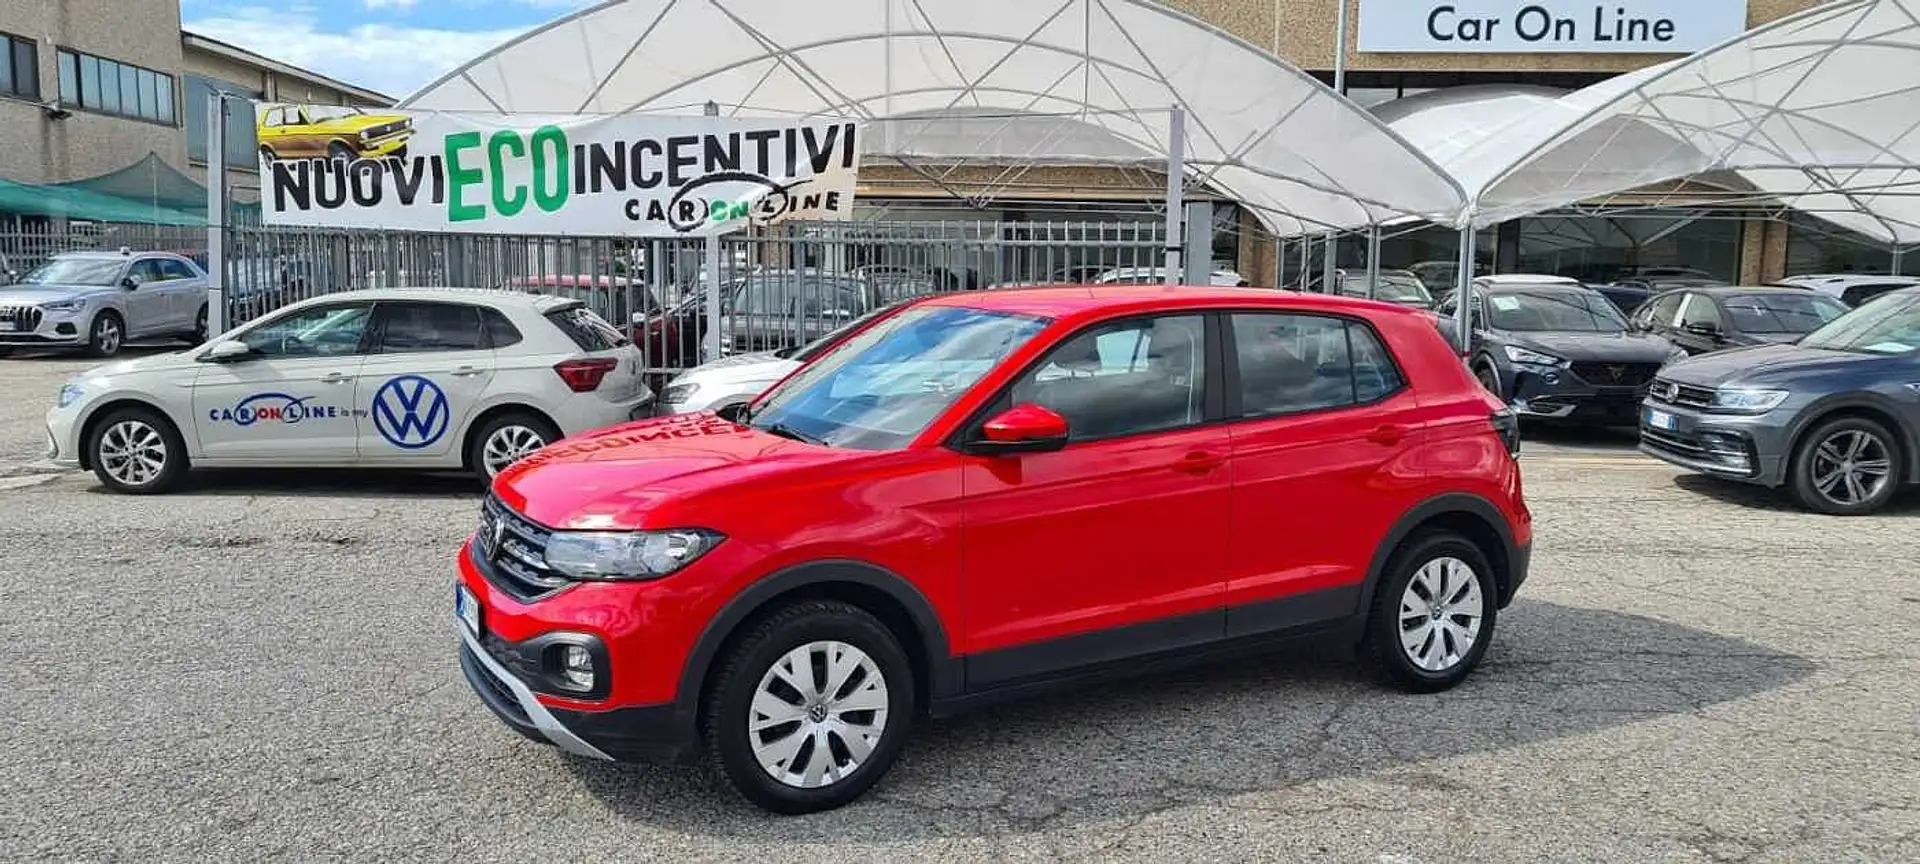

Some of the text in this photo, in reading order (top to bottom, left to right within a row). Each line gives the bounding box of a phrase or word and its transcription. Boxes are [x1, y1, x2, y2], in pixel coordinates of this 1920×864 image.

[1427, 6, 1675, 41] Car On Line
